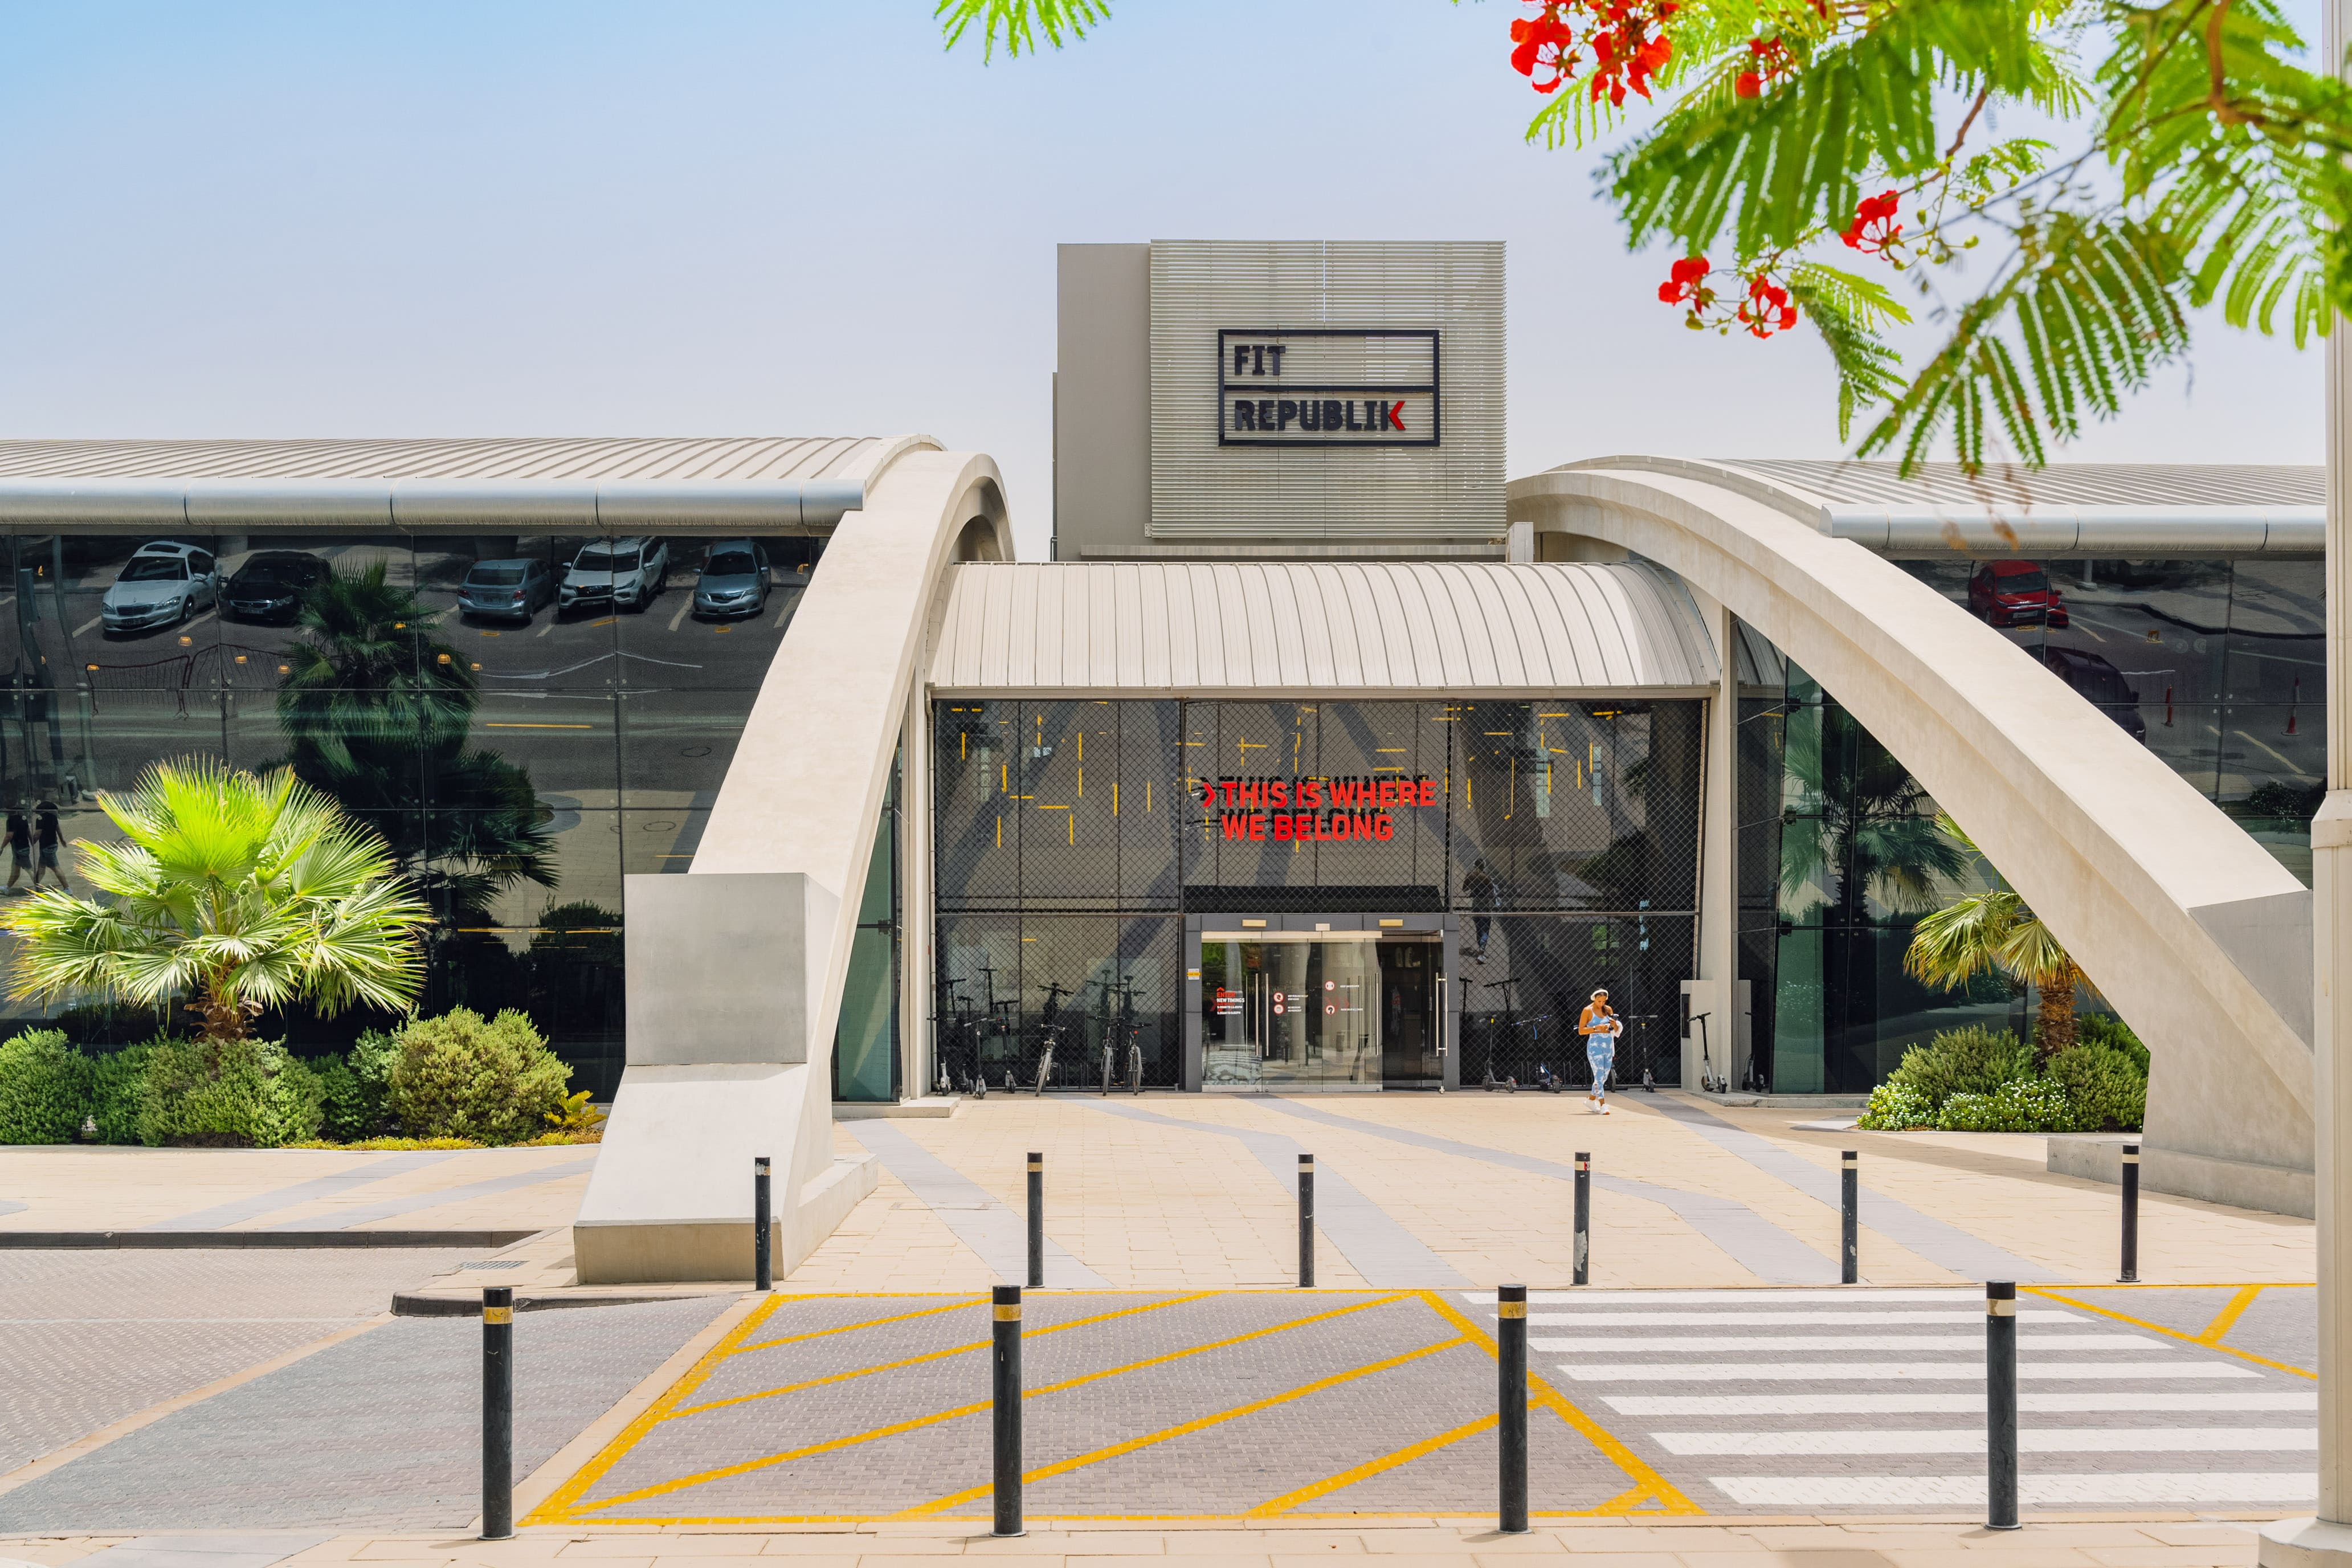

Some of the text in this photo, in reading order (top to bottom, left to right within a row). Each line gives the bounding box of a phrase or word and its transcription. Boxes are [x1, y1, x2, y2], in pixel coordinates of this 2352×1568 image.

[1235, 345, 1286, 375] FIT
[1235, 401, 1406, 431] REPUBLIK
[1221, 781, 1437, 807] THIS IS WHERE
[1221, 815, 1393, 840] WE BELONG
